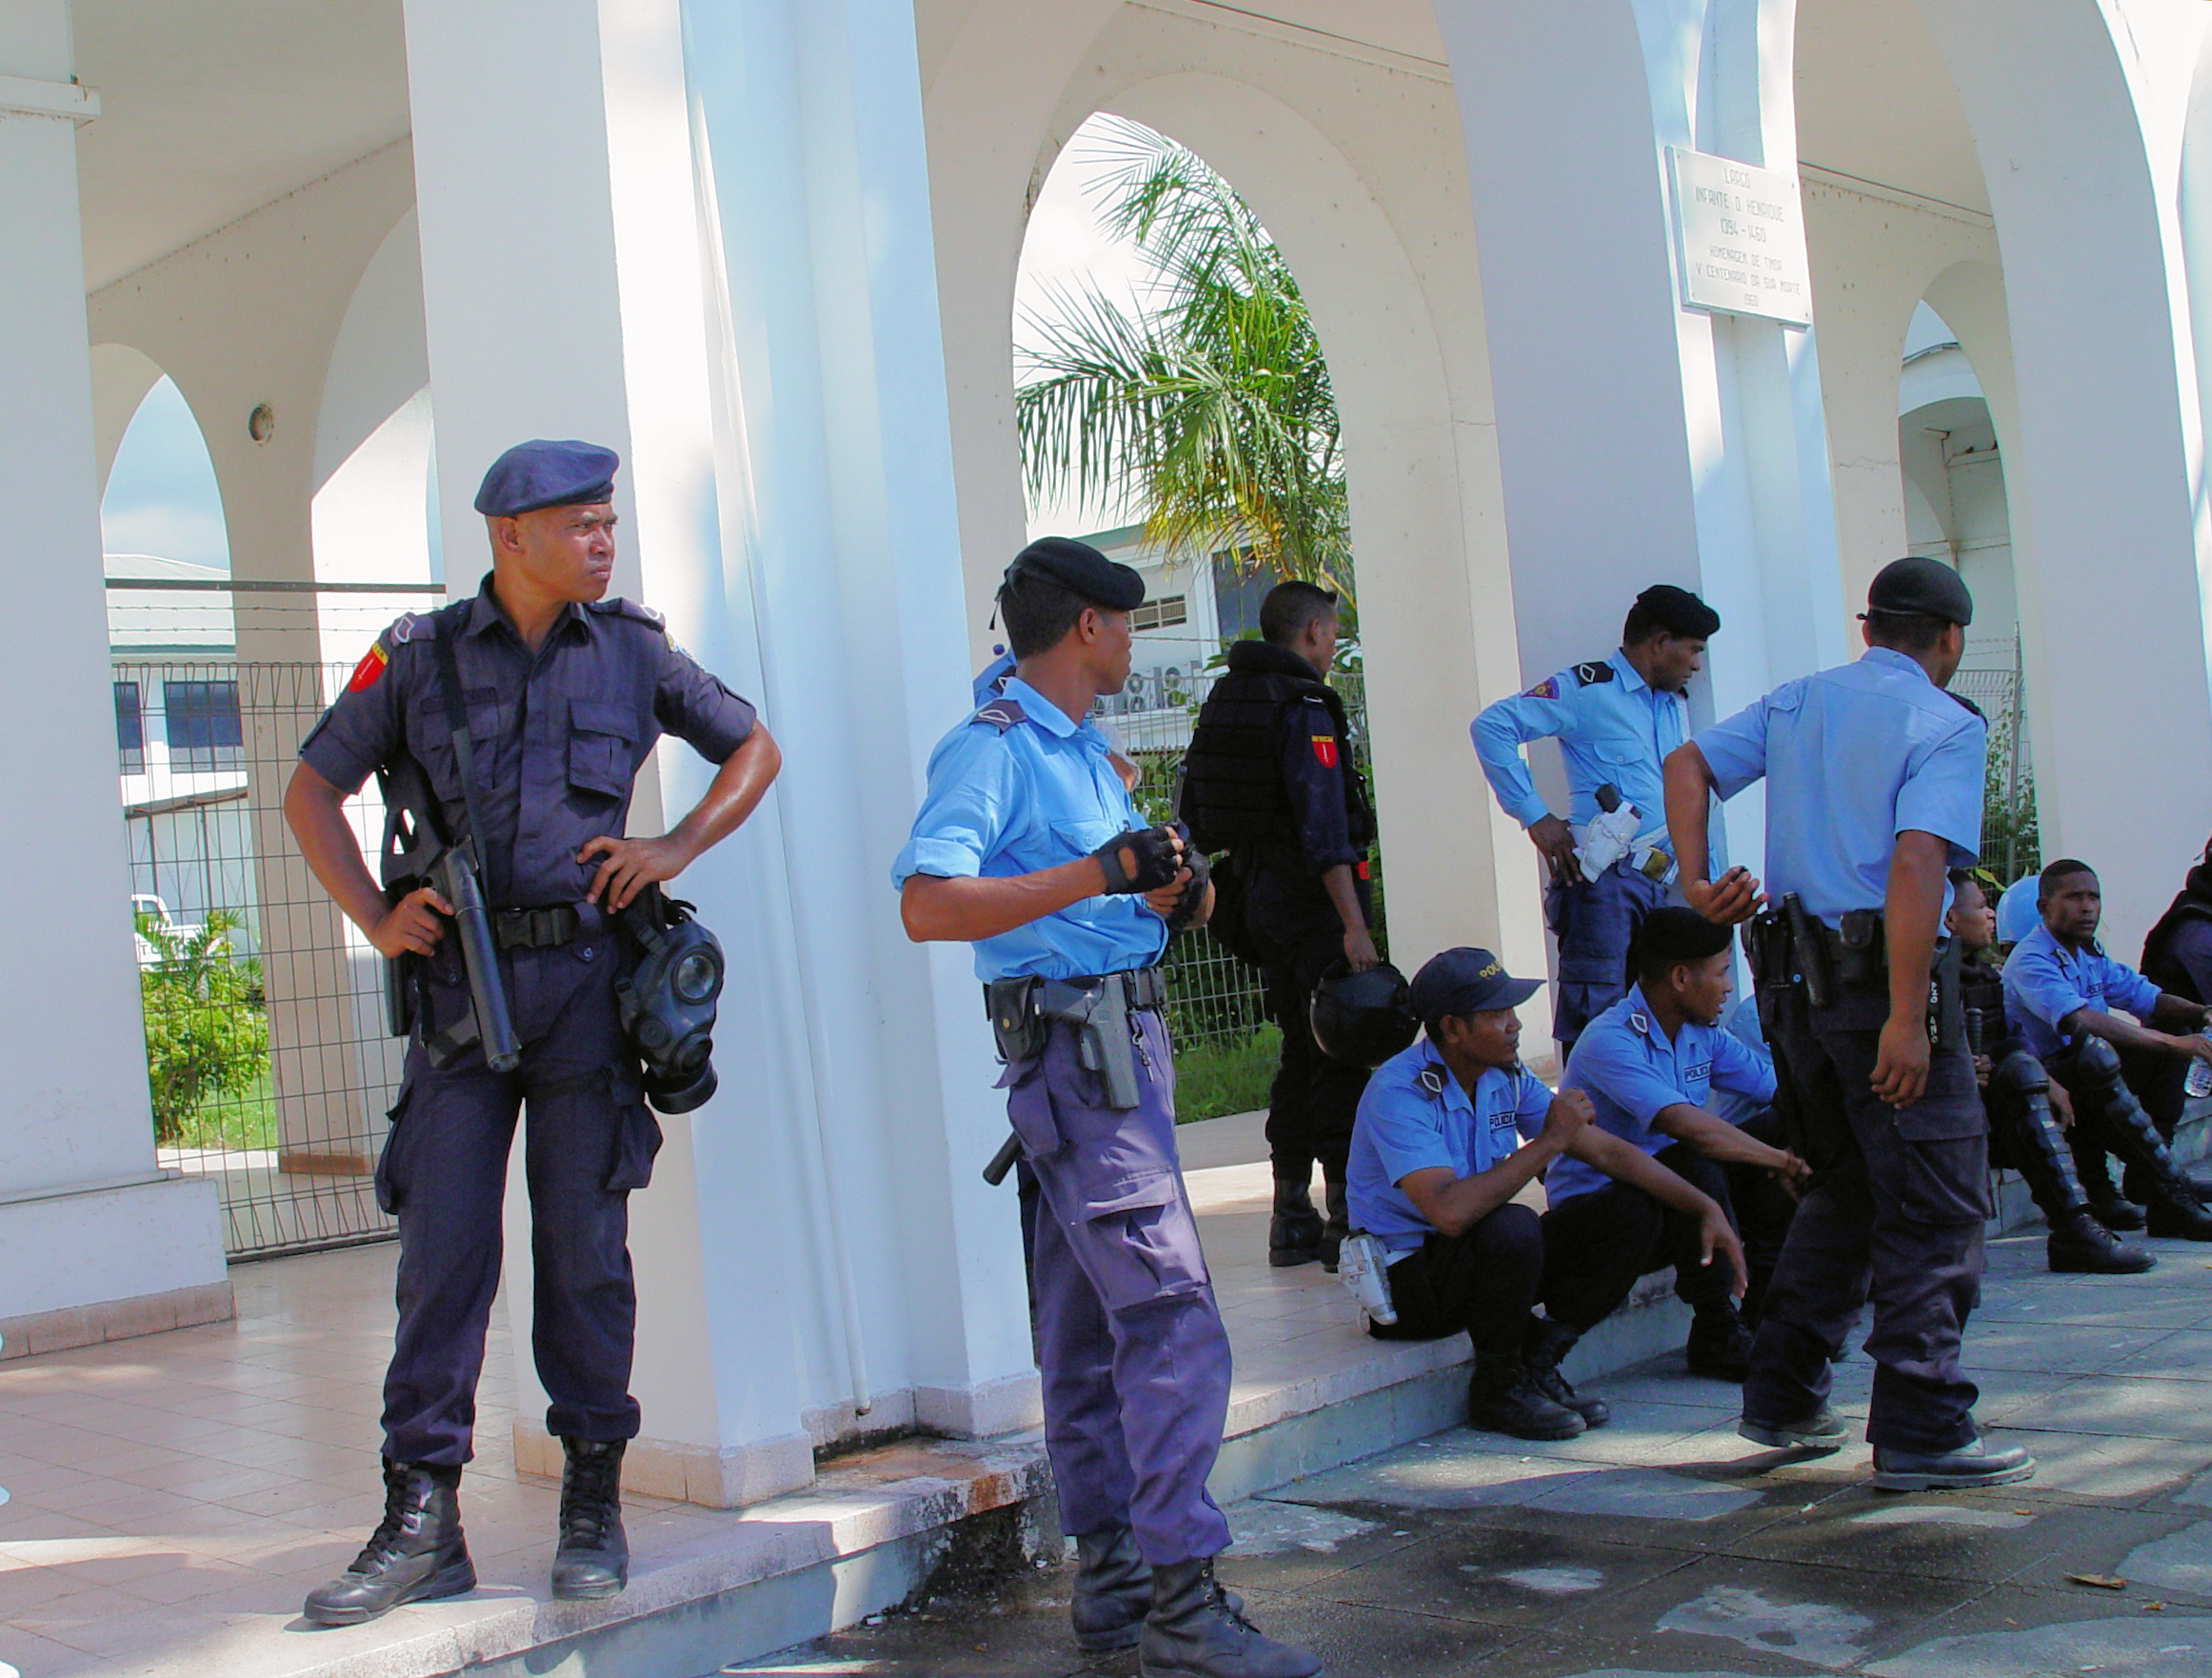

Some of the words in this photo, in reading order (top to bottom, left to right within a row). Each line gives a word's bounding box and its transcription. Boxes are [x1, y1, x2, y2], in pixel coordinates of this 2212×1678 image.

[1724, 167, 1751, 190] LARGO
[1695, 186, 1730, 210] INFANTE
[1746, 199, 1784, 223] HENRIQUE
[1708, 244, 1748, 265] HOMENAGEM
[1751, 253, 1761, 268] DE
[1695, 262, 1703, 275] V
